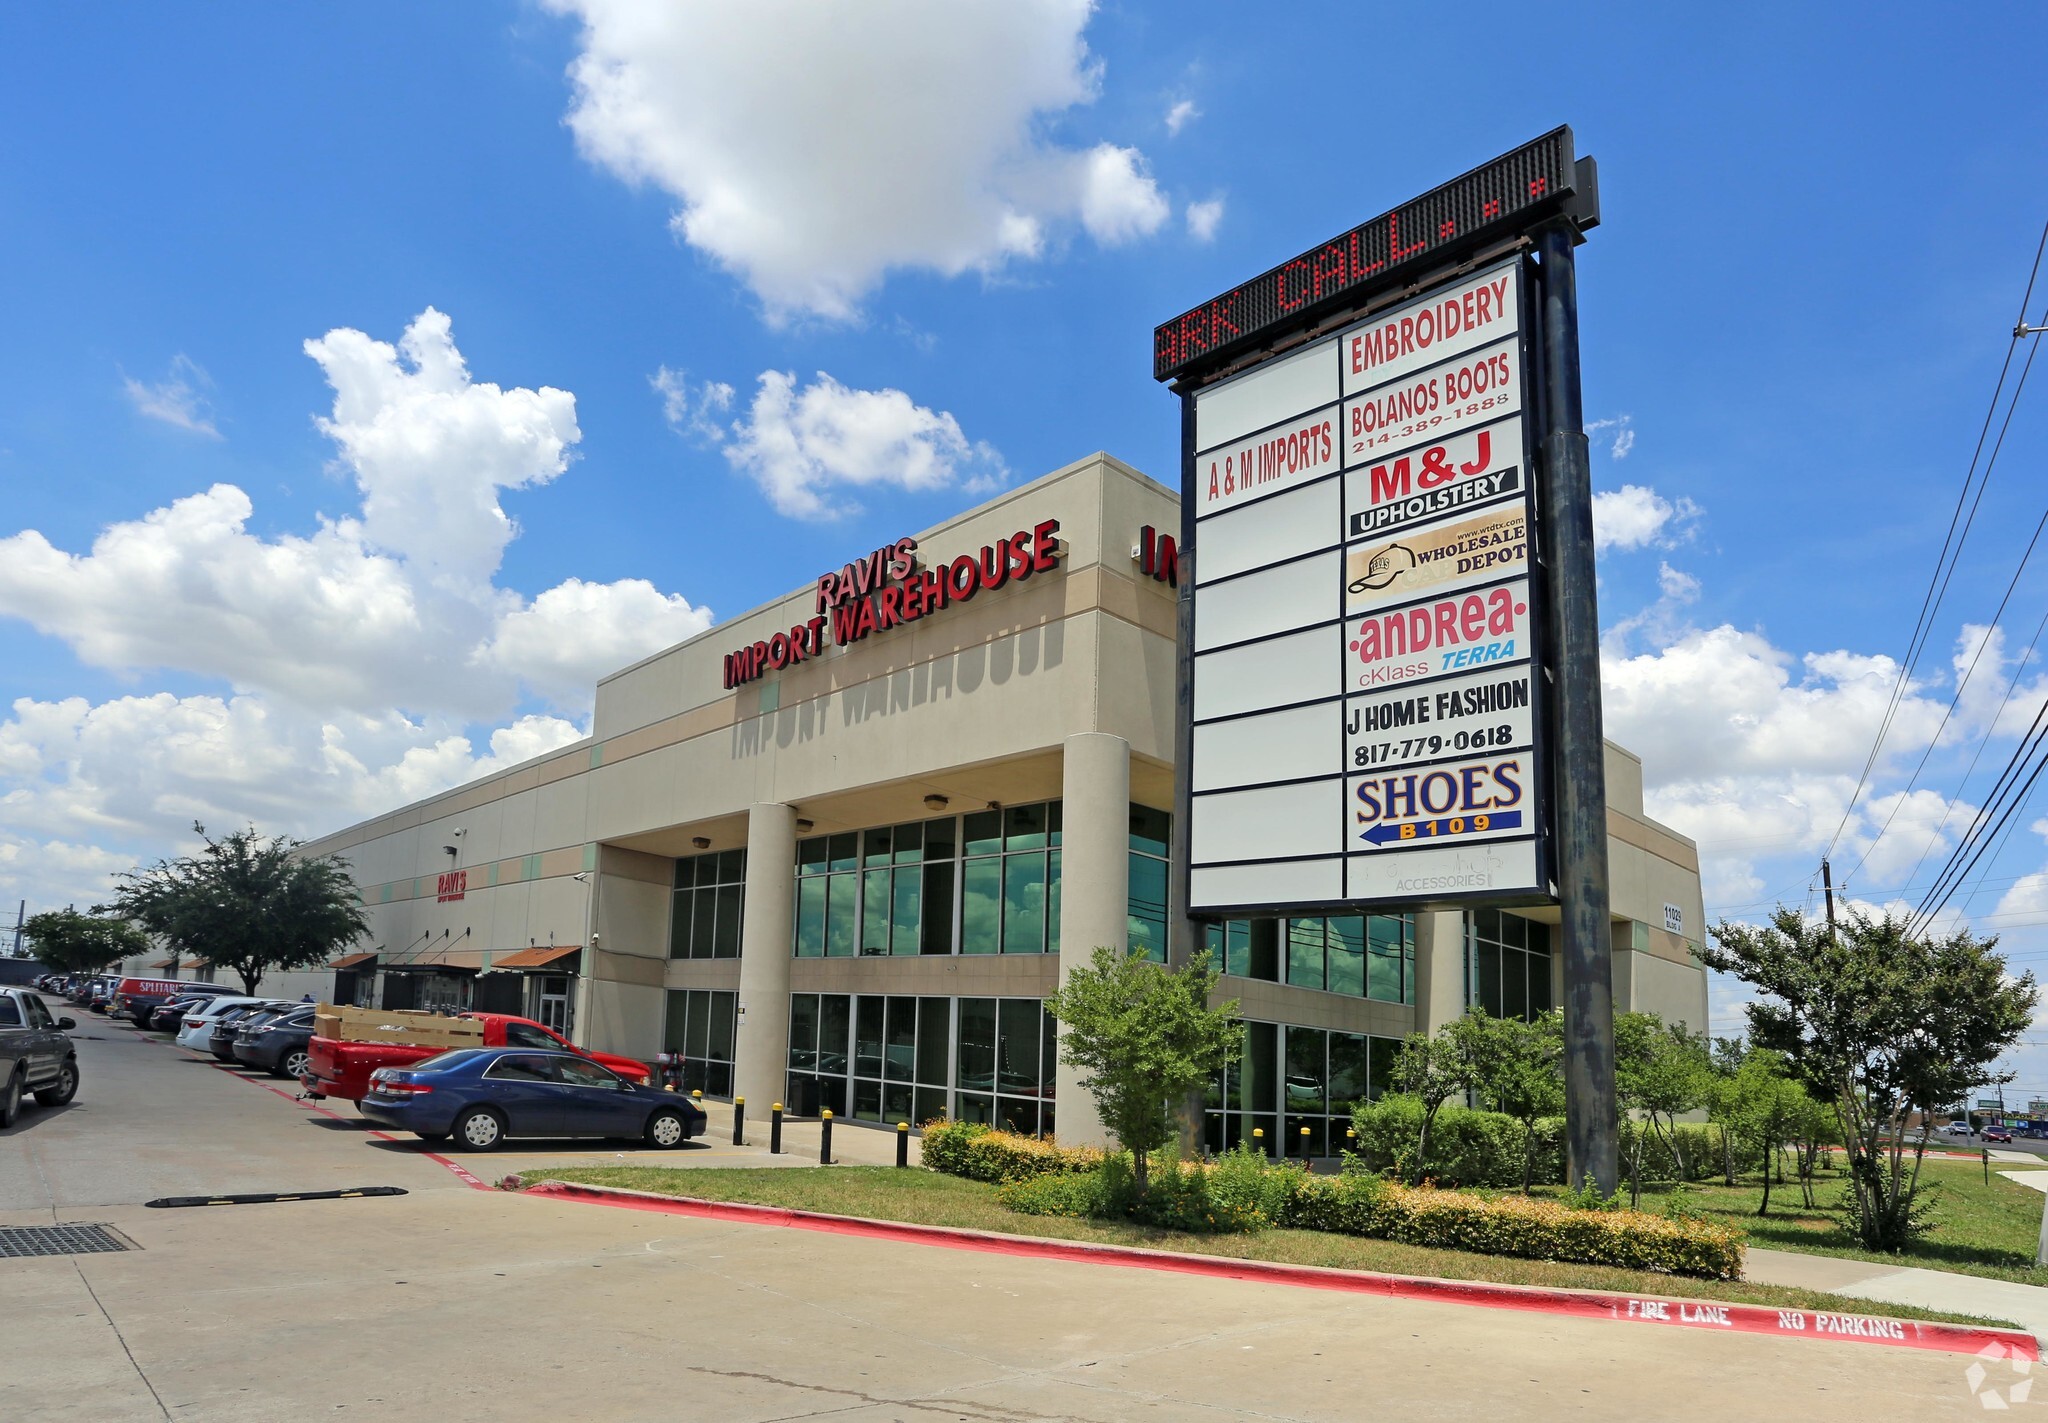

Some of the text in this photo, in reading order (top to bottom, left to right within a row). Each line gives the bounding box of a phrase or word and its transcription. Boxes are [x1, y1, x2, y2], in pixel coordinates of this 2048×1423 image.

[1351, 276, 1509, 375] EMBROIDERY
[1352, 352, 1510, 437] BOLANOS BOOTS
[1352, 393, 1509, 454] 214-389-1888
[1208, 421, 1332, 501] A & M IMPORTS
[1360, 471, 1507, 531] UPHOLSTERY
[1457, 517, 1524, 540] www.wtdtx.com
[1417, 525, 1526, 564] WHOLESALE
[1457, 543, 1527, 574] DEPOT
[723, 518, 1060, 690] IMPORT WAREHOUSE
[817, 537, 918, 613] RAVI'S
[1441, 639, 1515, 671] TERRA
[1347, 678, 1529, 735] J HOME FASHION
[1356, 760, 1522, 824] SHOES
[1395, 873, 1486, 892] ACCESSORIES
[1628, 1300, 1905, 1340] FIRE LANE NO PARKING
